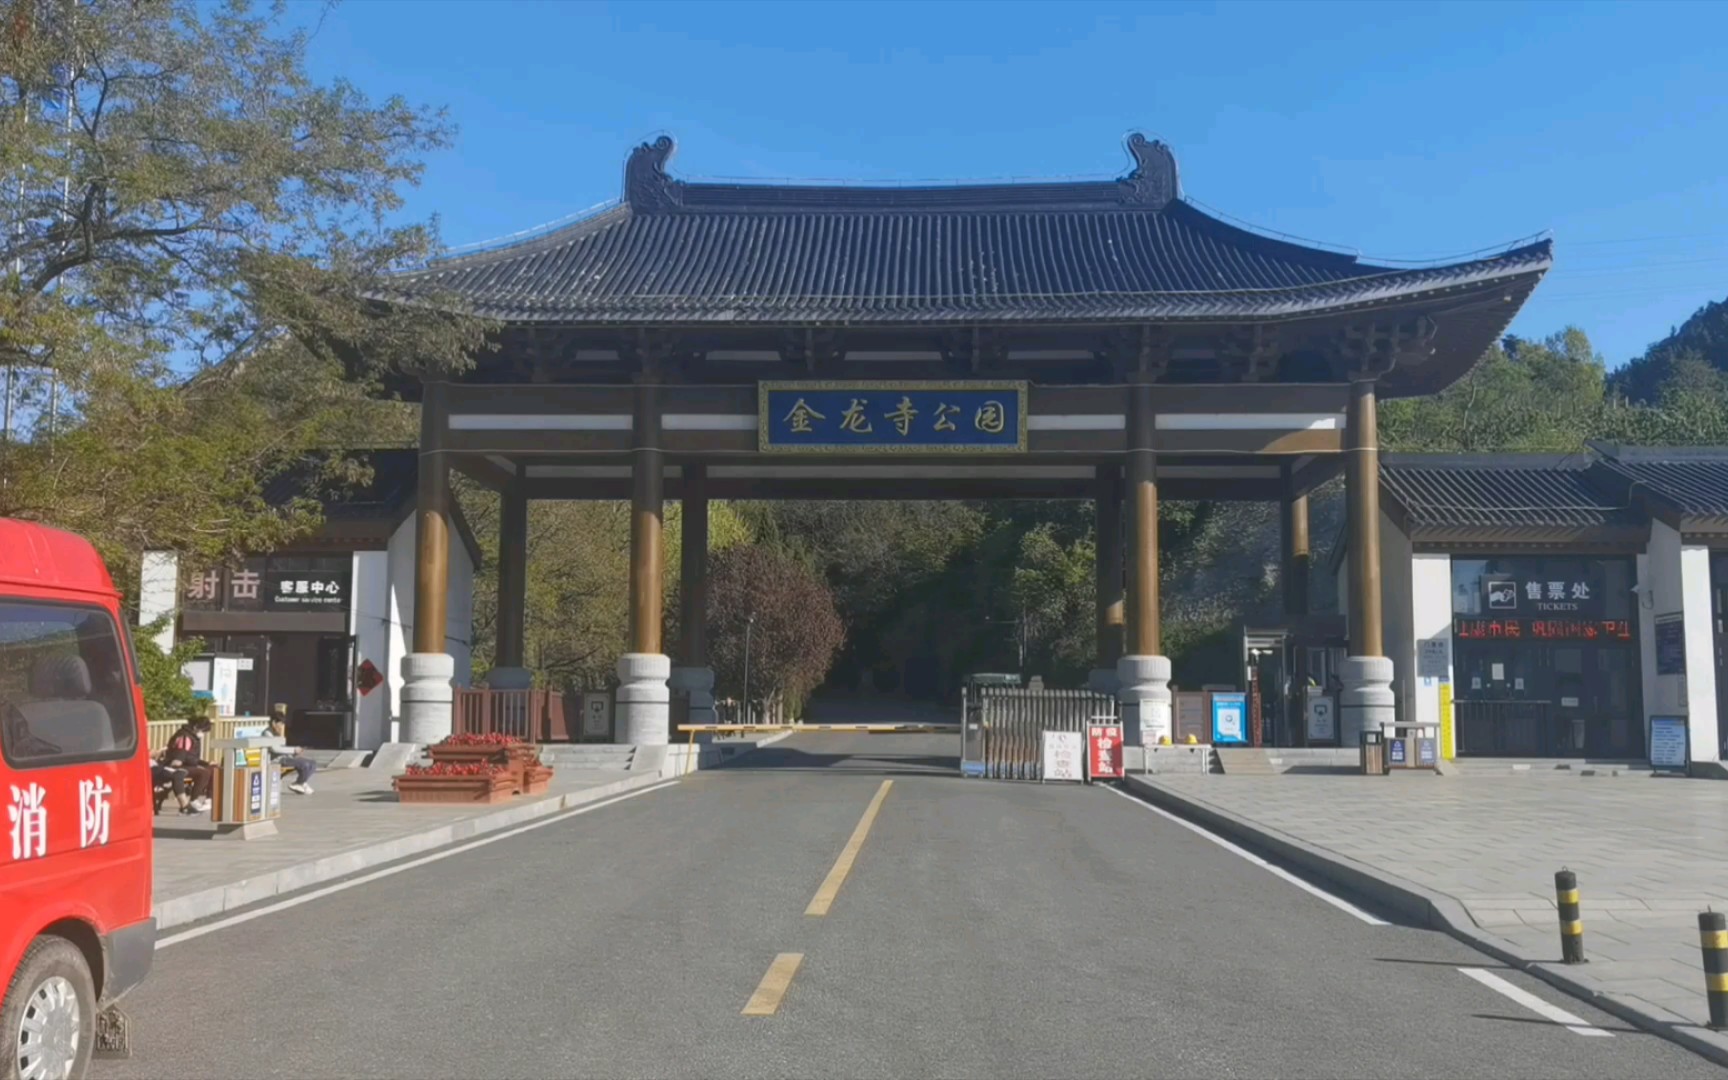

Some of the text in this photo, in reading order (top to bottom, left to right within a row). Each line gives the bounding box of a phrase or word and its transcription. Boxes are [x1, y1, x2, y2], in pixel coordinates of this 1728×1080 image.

[783, 397, 1004, 436] 金龙寺公园
[187, 569, 261, 599] 射击
[280, 580, 340, 595] 客服中心
[1525, 581, 1590, 600] 售票处
[1537, 602, 1578, 611] TICKETS
[8, 775, 112, 860] 消防
